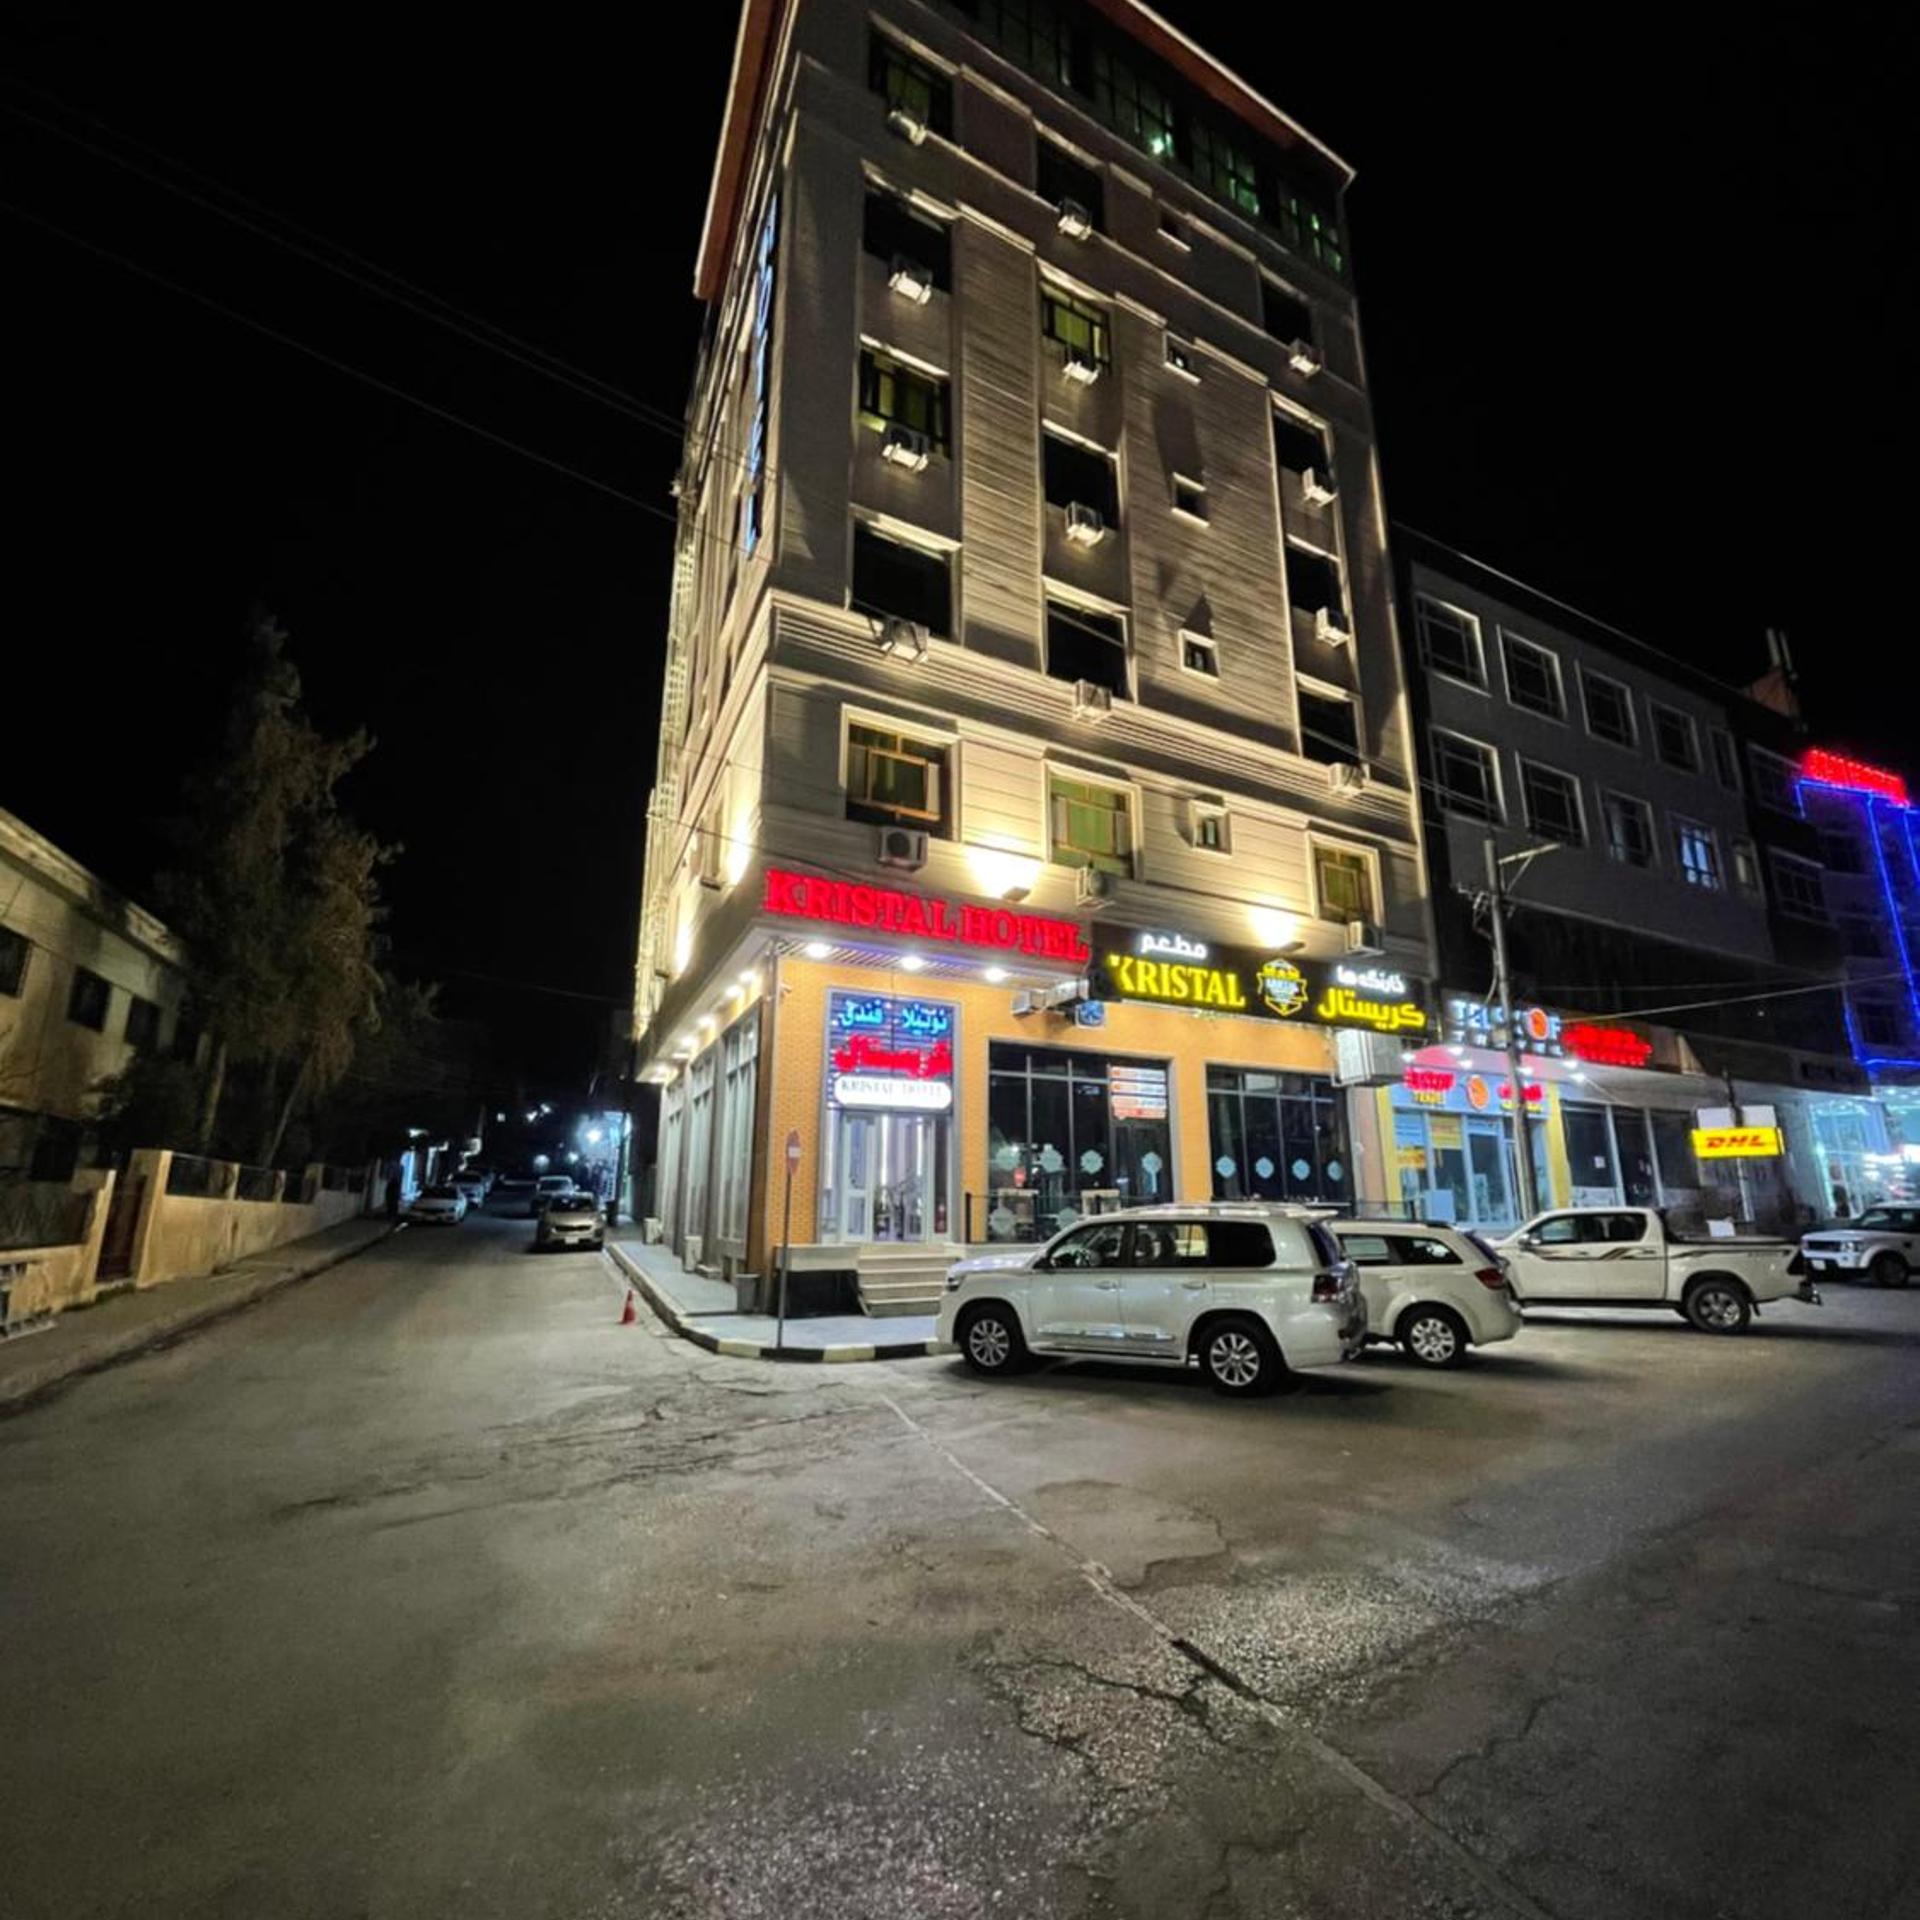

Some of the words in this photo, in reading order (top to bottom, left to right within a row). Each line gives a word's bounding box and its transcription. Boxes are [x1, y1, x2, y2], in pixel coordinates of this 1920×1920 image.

[764, 869, 955, 941] KRISTAL
[961, 903, 1089, 962] HOTEL
[1140, 933, 1208, 960] مطعم
[1107, 953, 1246, 1009] KRISTAL
[1706, 1135, 1765, 1149] DHL
